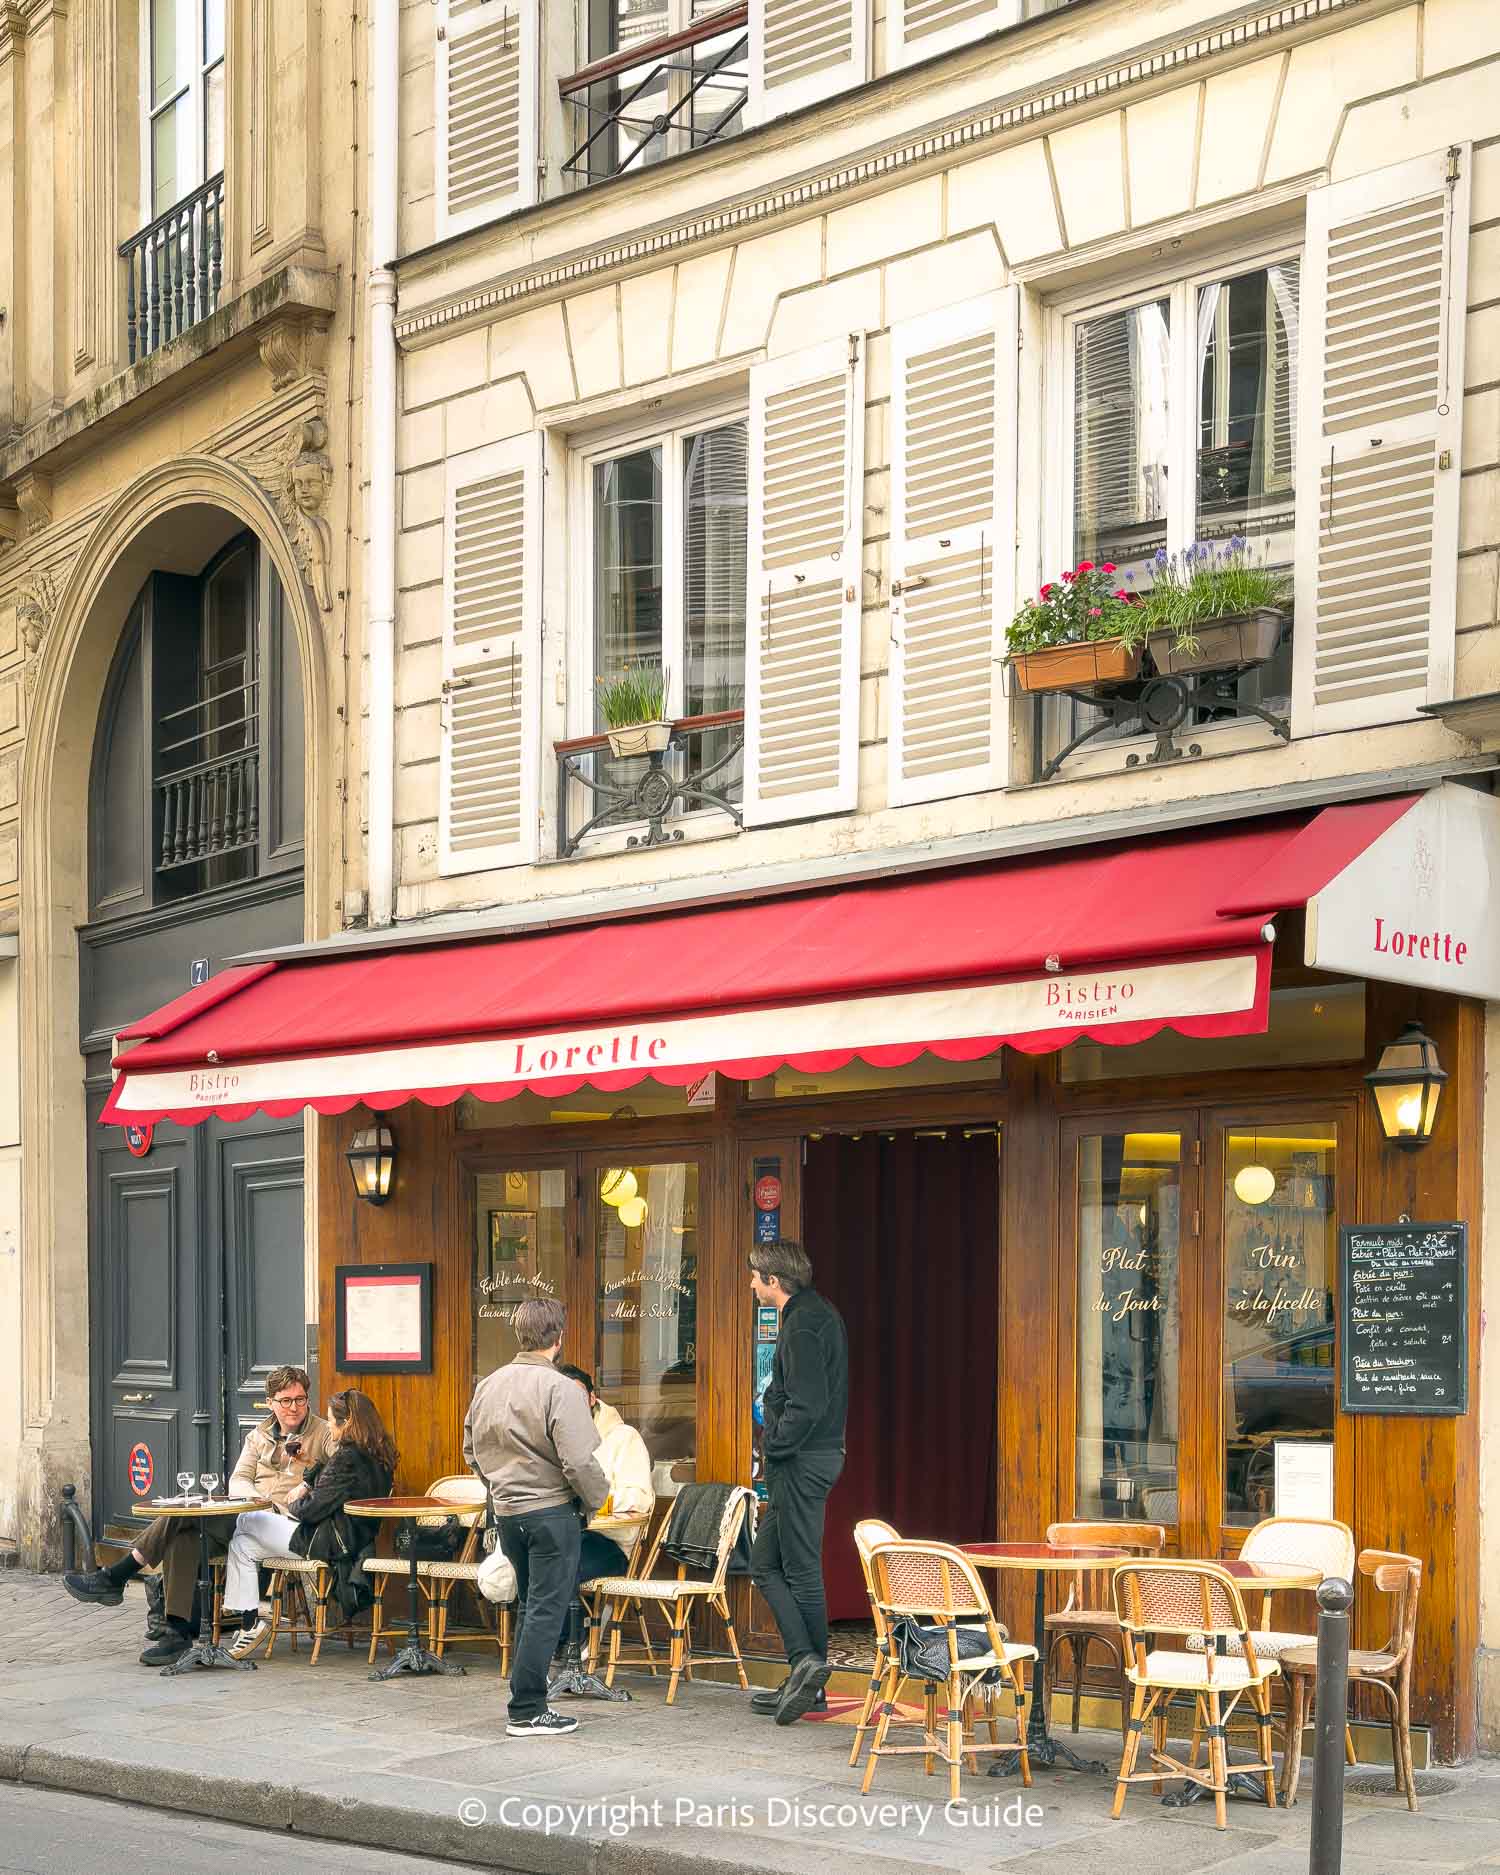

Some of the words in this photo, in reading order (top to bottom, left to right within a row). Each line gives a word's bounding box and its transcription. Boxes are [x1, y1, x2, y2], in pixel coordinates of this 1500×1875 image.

[1374, 918, 1467, 965] Lorette
[196, 963, 203, 983] 7
[1047, 982, 1134, 1006] Bistro
[1059, 1004, 1117, 1020] PARISIEN
[514, 1035, 667, 1074] Lorette
[190, 1074, 239, 1091] Bistro
[1100, 1247, 1150, 1272] Plat
[1252, 1244, 1300, 1269] Vin
[480, 1271, 510, 1295] Table
[513, 1273, 526, 1284] des
[527, 1271, 554, 1294] Amis
[605, 1270, 636, 1295] Ouvert
[479, 1304, 511, 1318] Cuisine
[611, 1301, 639, 1318] Midi
[649, 1303, 674, 1319] Soir
[1092, 1291, 1113, 1312] du
[1112, 1288, 1161, 1321] Jour
[1235, 1290, 1249, 1310] à
[1252, 1289, 1269, 1310] la
[1266, 1287, 1321, 1323] ficelle
